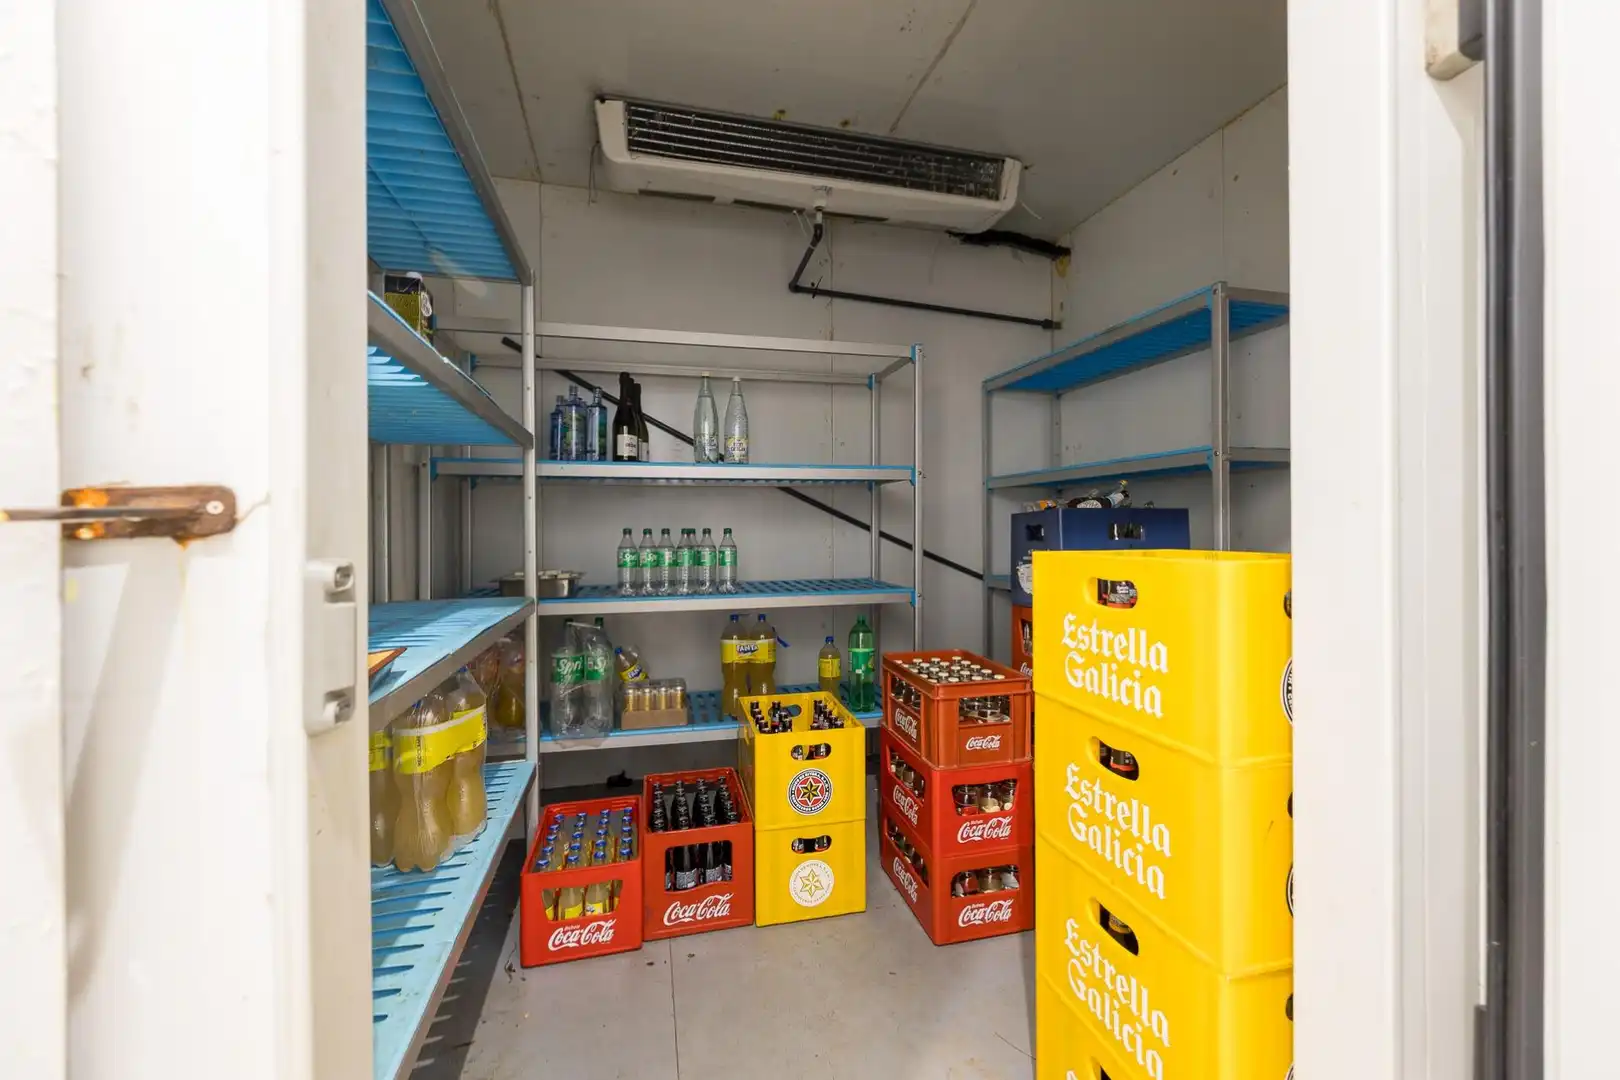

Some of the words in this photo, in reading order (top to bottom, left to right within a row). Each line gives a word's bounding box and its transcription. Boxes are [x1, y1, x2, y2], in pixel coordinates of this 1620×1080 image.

[1061, 612, 1169, 674] Estrella
[1064, 650, 1163, 718] Galicia
[966, 735, 1002, 751] Coca-Cola
[957, 815, 1013, 844] Coca-Cola
[1064, 763, 1171, 858] Estrella
[1068, 802, 1165, 900] Galicia
[547, 918, 617, 952] Coca-Cola
[663, 892, 734, 926] Coca-Cola
[958, 899, 1014, 928] Coca-Cola
[1064, 918, 1170, 1047] Estrella
[1068, 957, 1164, 1080] Galicia
